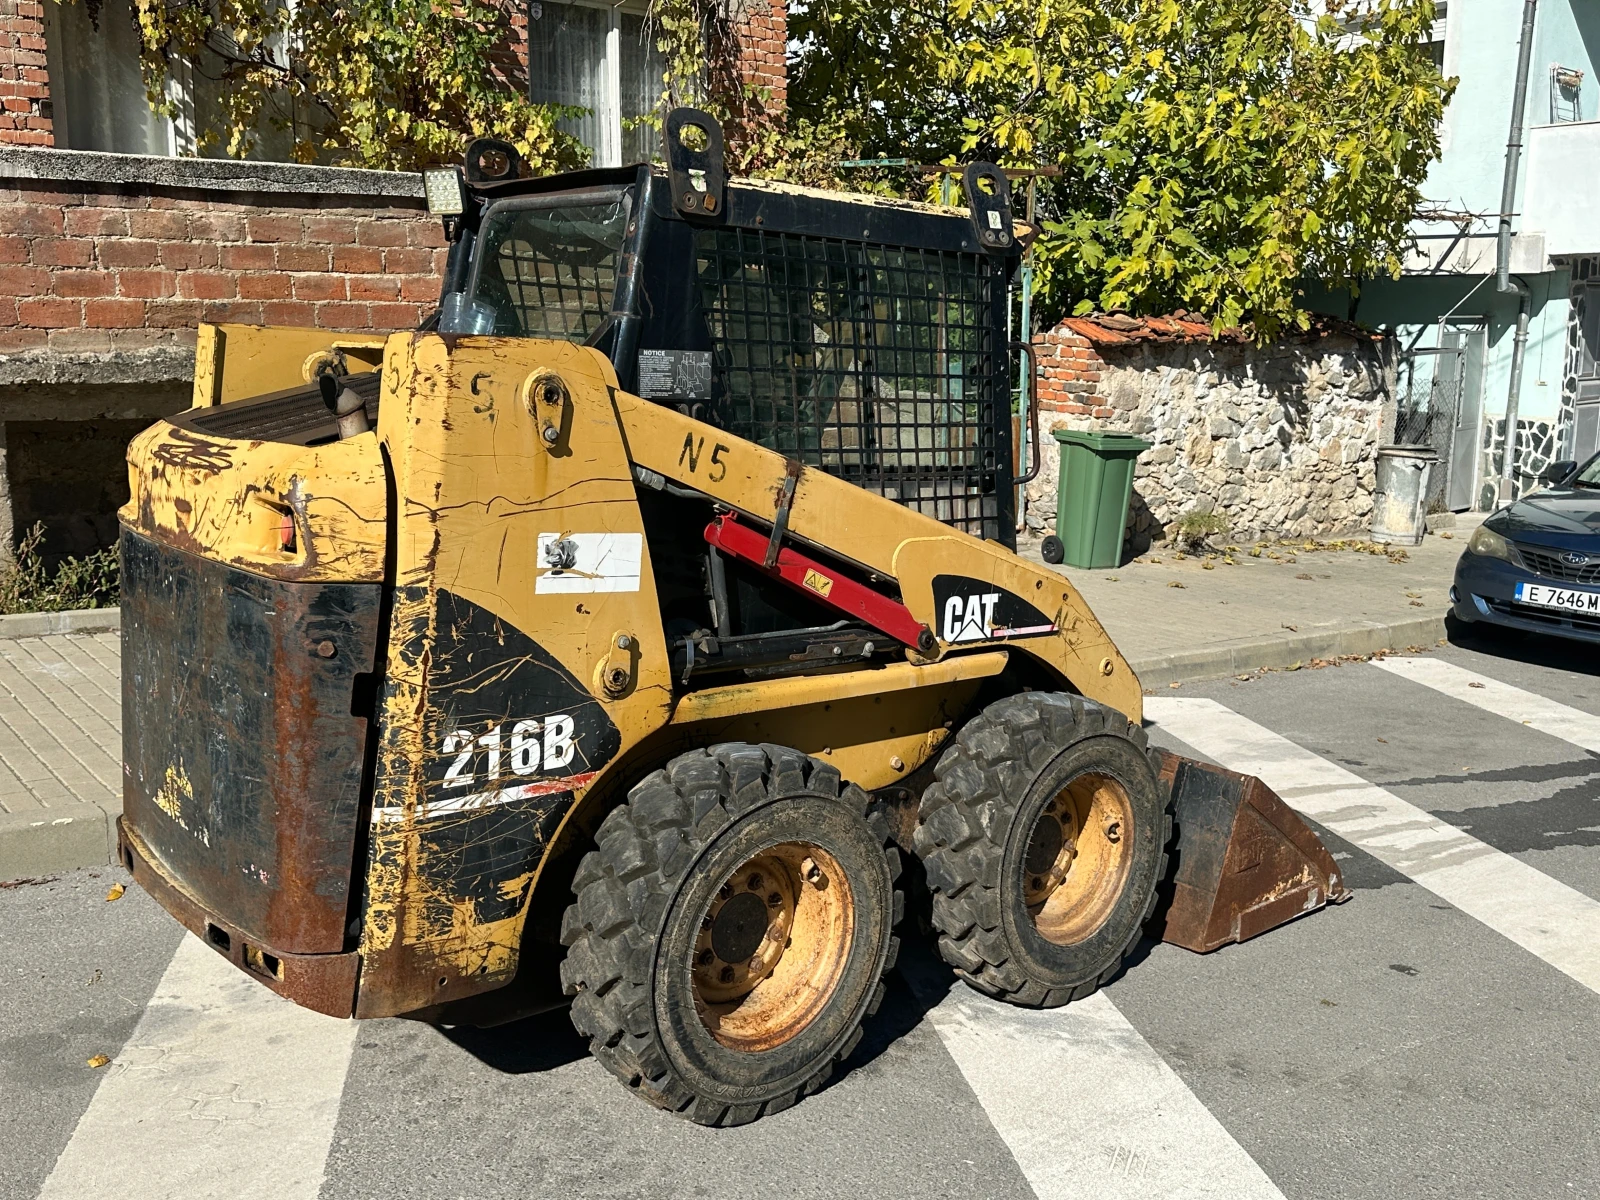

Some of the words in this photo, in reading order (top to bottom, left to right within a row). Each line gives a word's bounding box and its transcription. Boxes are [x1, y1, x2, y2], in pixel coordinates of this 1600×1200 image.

[643, 349, 666, 357] NOTICE
[678, 431, 705, 474] N
[708, 442, 731, 483] 5
[943, 593, 999, 643] CAT
[1529, 586, 1540, 602] E
[1547, 589, 1585, 608] 7646
[442, 714, 575, 789] 216B
